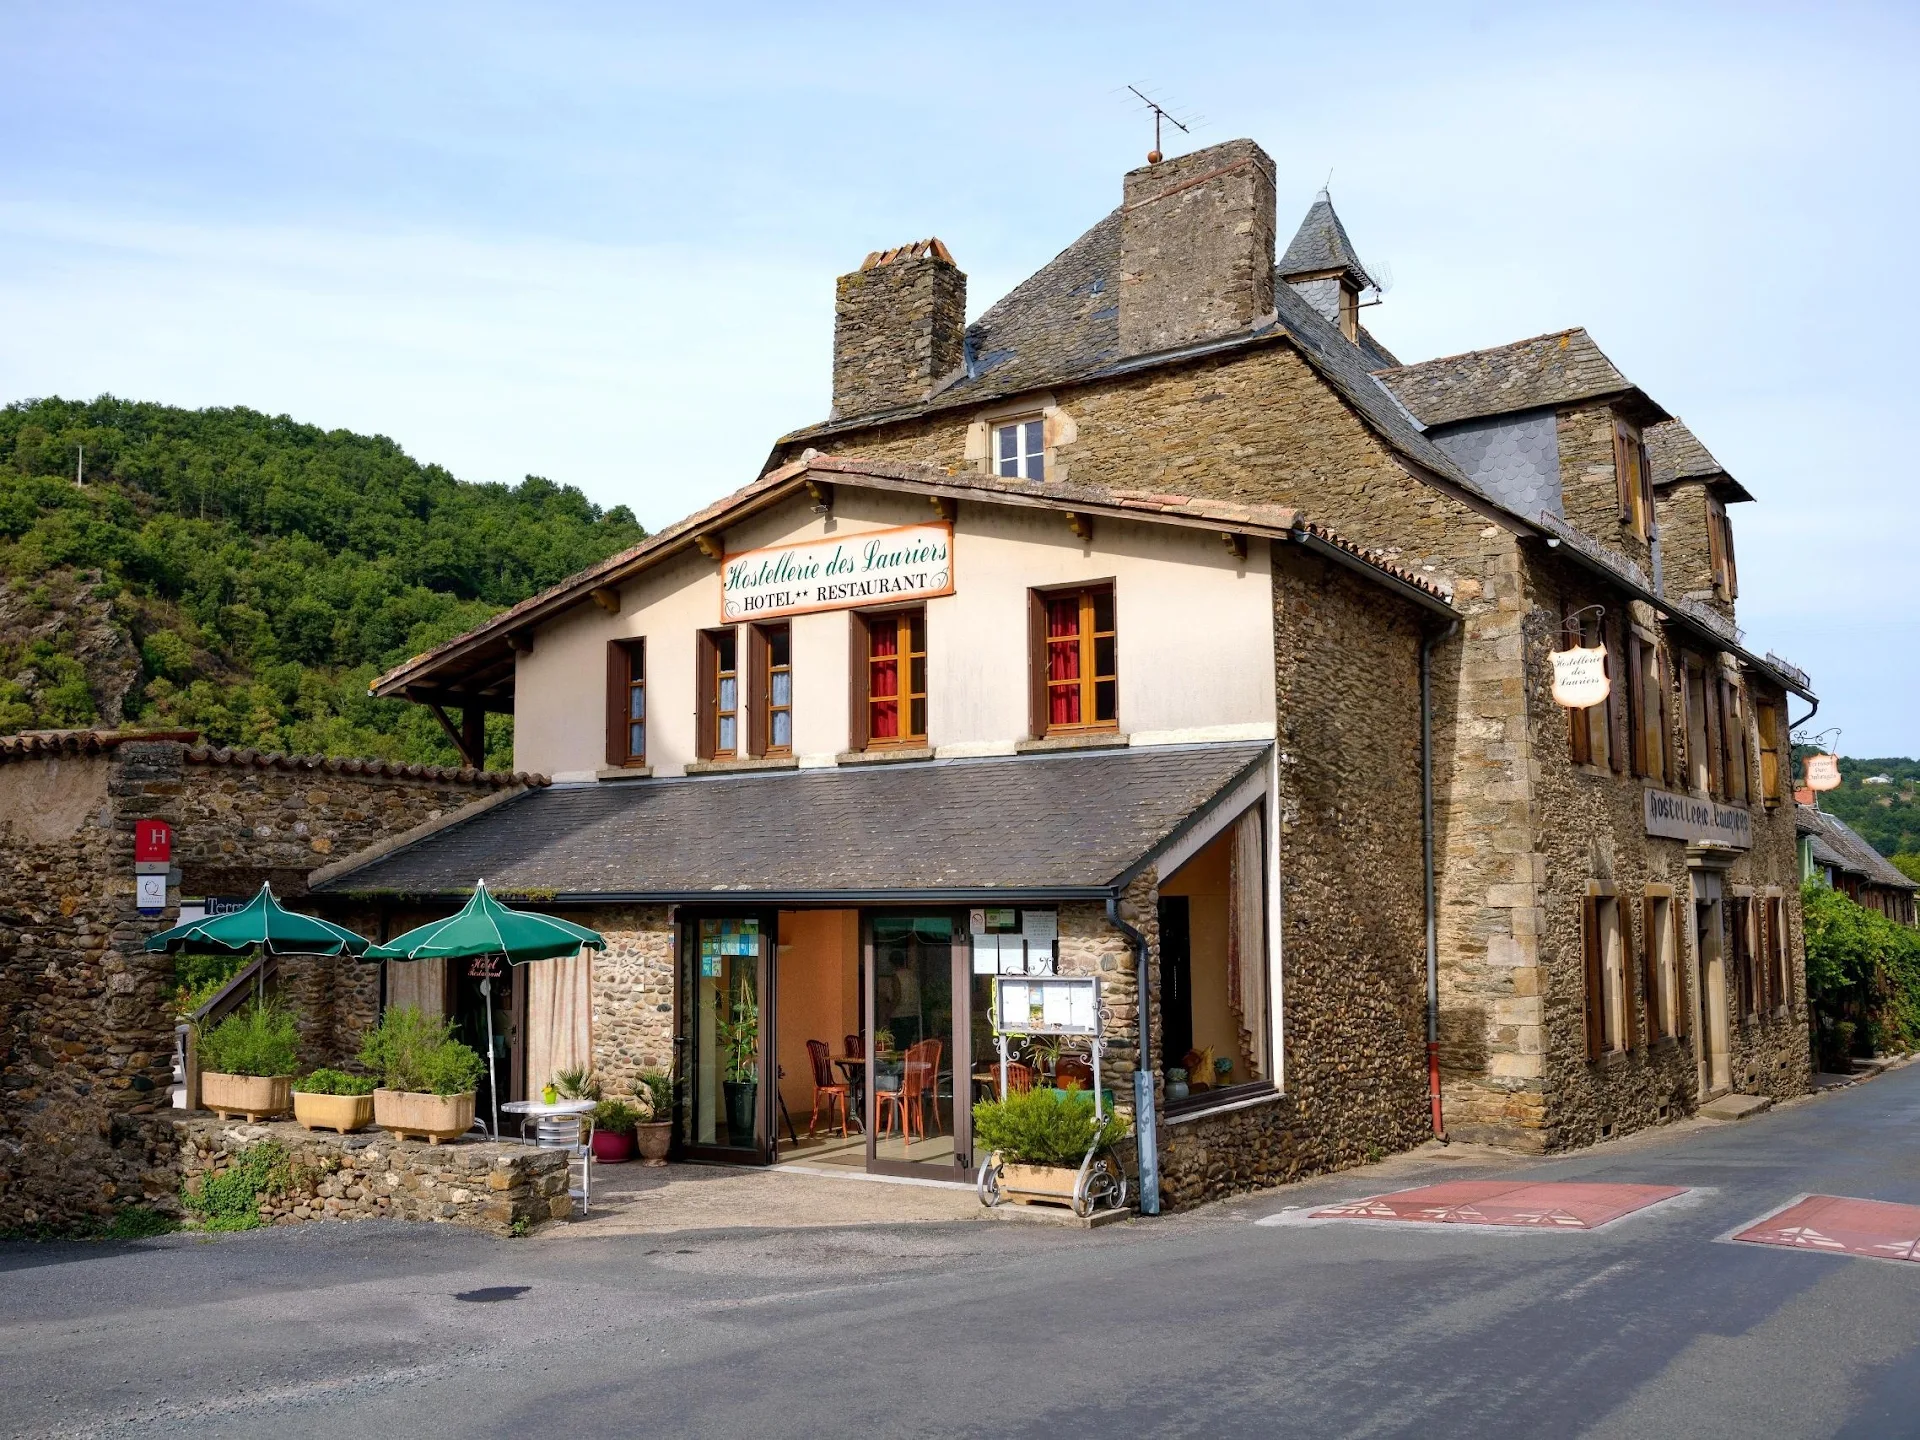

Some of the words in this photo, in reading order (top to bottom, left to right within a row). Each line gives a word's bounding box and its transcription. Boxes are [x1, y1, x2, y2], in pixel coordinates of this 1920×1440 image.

[724, 550, 820, 592] Hostellerie
[825, 545, 855, 577] des
[861, 538, 948, 573] Lauriers
[816, 573, 928, 602] RESTAURANT
[1555, 654, 1601, 667] Hostellerie
[1571, 667, 1586, 676] des
[1560, 676, 1600, 687] Lauriers
[151, 829, 166, 845] H
